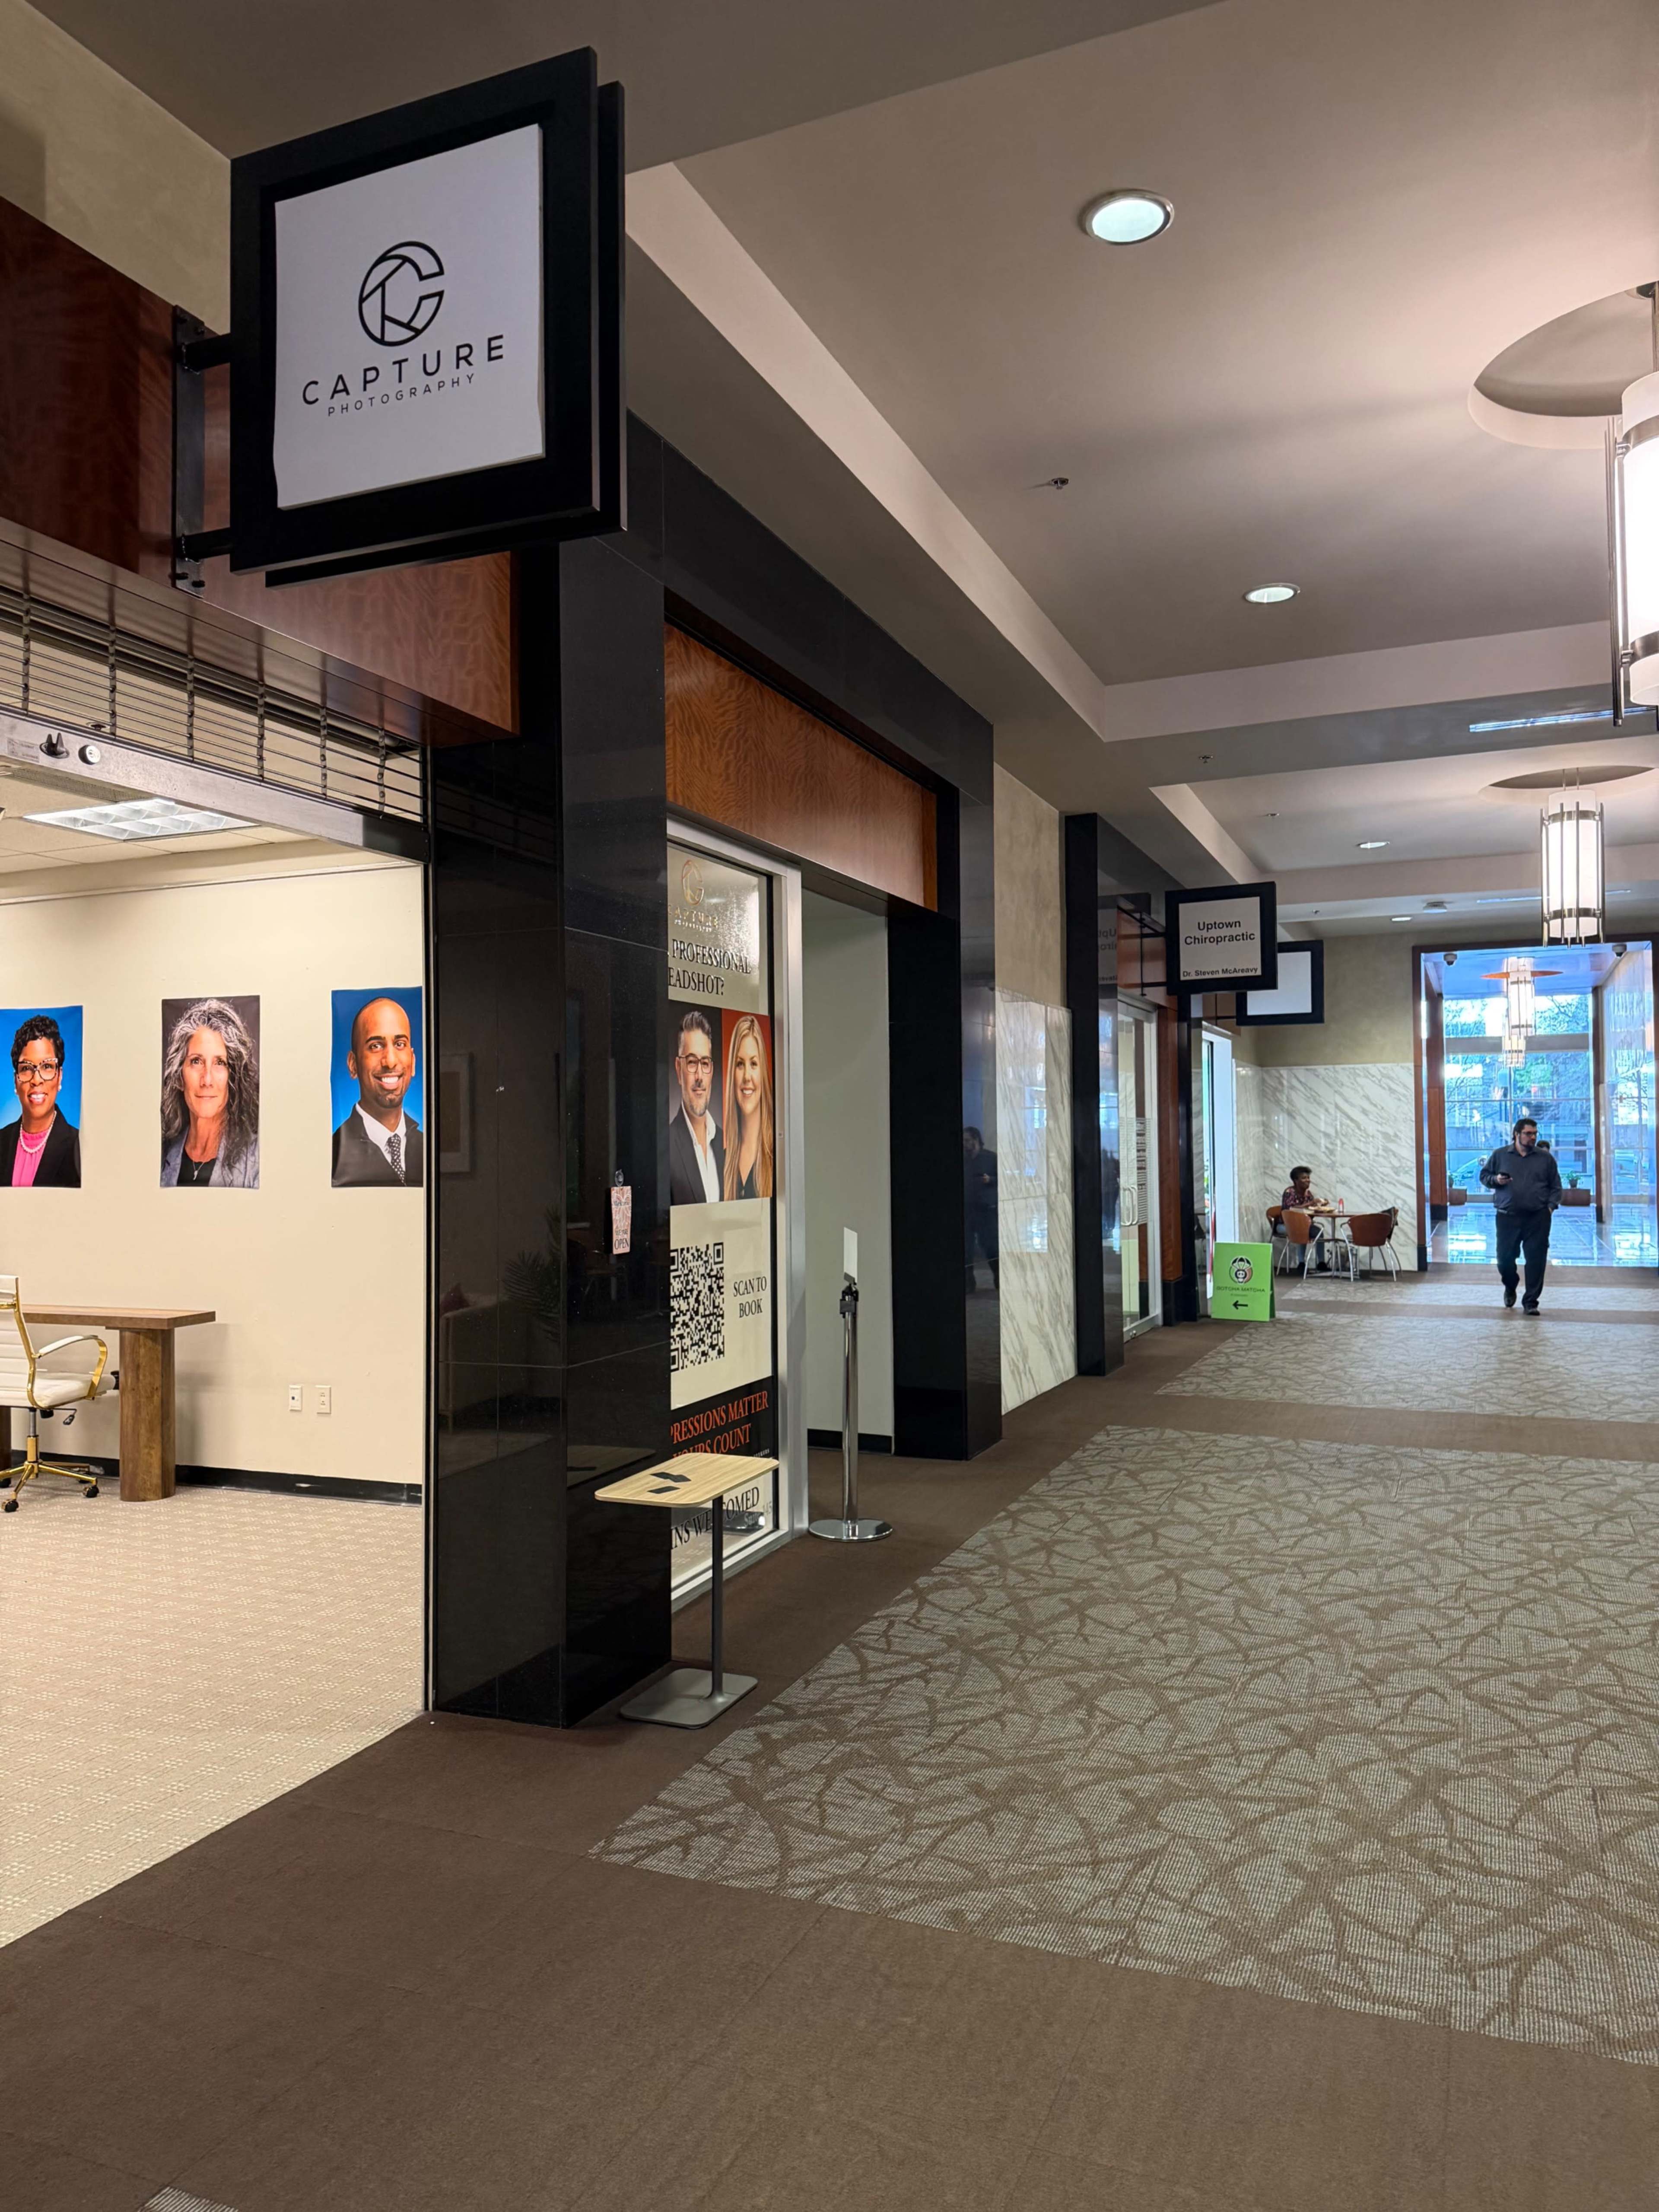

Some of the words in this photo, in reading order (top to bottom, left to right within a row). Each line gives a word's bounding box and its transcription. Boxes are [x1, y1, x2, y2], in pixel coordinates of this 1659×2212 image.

[302, 334, 504, 405] CAPTURE
[327, 373, 474, 417] PHOTOGRAPHY
[1185, 932, 1255, 945] Chiropractic
[1198, 921, 1241, 932] Uptown
[672, 939, 751, 974] PROFESSIONAL
[614, 1237, 629, 1250] OPEN
[734, 1279, 754, 1297] SCAN
[756, 1276, 766, 1292] TO
[739, 1298, 763, 1318] BOOK
[728, 1391, 769, 1422] MATTER
[714, 1423, 751, 1454] COUNT
[693, 1487, 759, 1537] WEOMED
